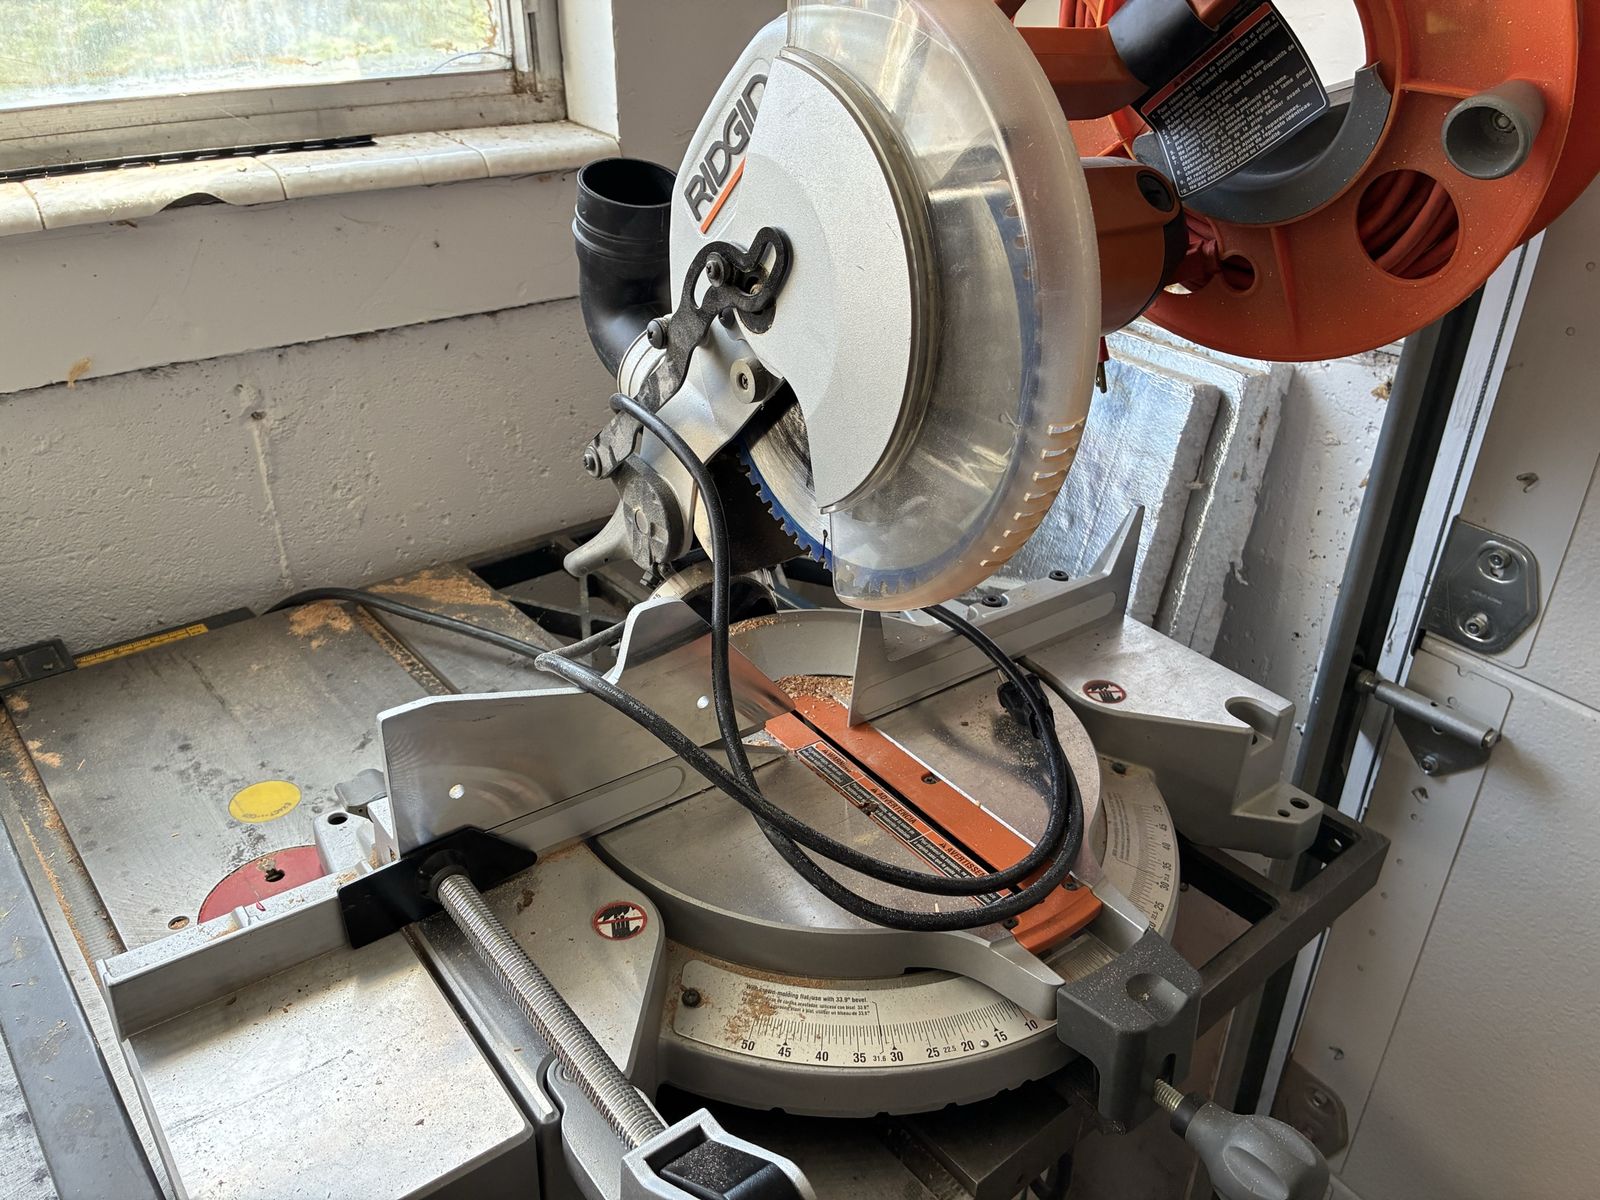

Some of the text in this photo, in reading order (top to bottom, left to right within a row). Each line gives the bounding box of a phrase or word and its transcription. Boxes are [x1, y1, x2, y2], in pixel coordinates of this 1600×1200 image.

[684, 74, 768, 221] RIDGID
[876, 790, 916, 824] ADVERTENCIA
[1160, 841, 1170, 850] 40
[945, 845, 985, 878] AVERTISSE
[1161, 861, 1172, 870] 35
[1159, 881, 1169, 890] 30
[1153, 900, 1164, 911] 25
[776, 990, 798, 999] molding
[1024, 1019, 1039, 1031] 10
[994, 1031, 1008, 1043] 15
[740, 1039, 755, 1051] 50
[960, 1040, 975, 1052] 20
[778, 1047, 791, 1058] 45
[815, 1050, 829, 1062] 40
[852, 1051, 867, 1063] 35
[890, 1051, 904, 1062] 30
[926, 1046, 940, 1058] 25
